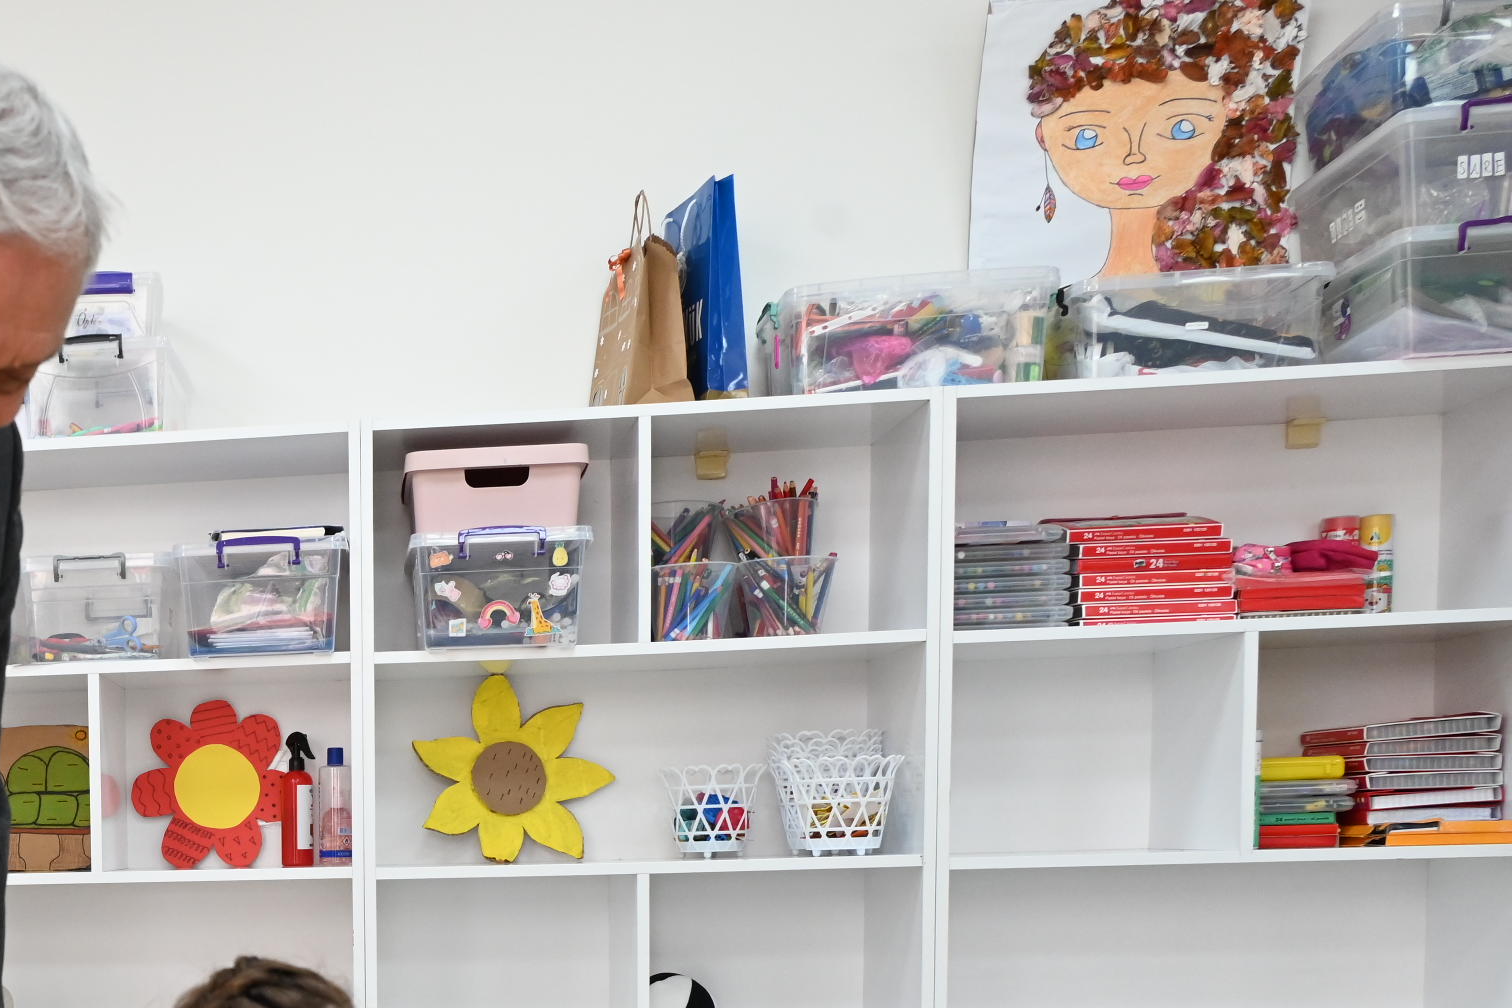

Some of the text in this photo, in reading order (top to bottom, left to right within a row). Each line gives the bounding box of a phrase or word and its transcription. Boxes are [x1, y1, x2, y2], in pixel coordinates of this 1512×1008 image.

[685, 298, 704, 346] ÜK
[1083, 532, 1093, 540] 24
[1095, 546, 1105, 554] 24
[1149, 559, 1164, 569] 24
[1098, 606, 1108, 614] 24
